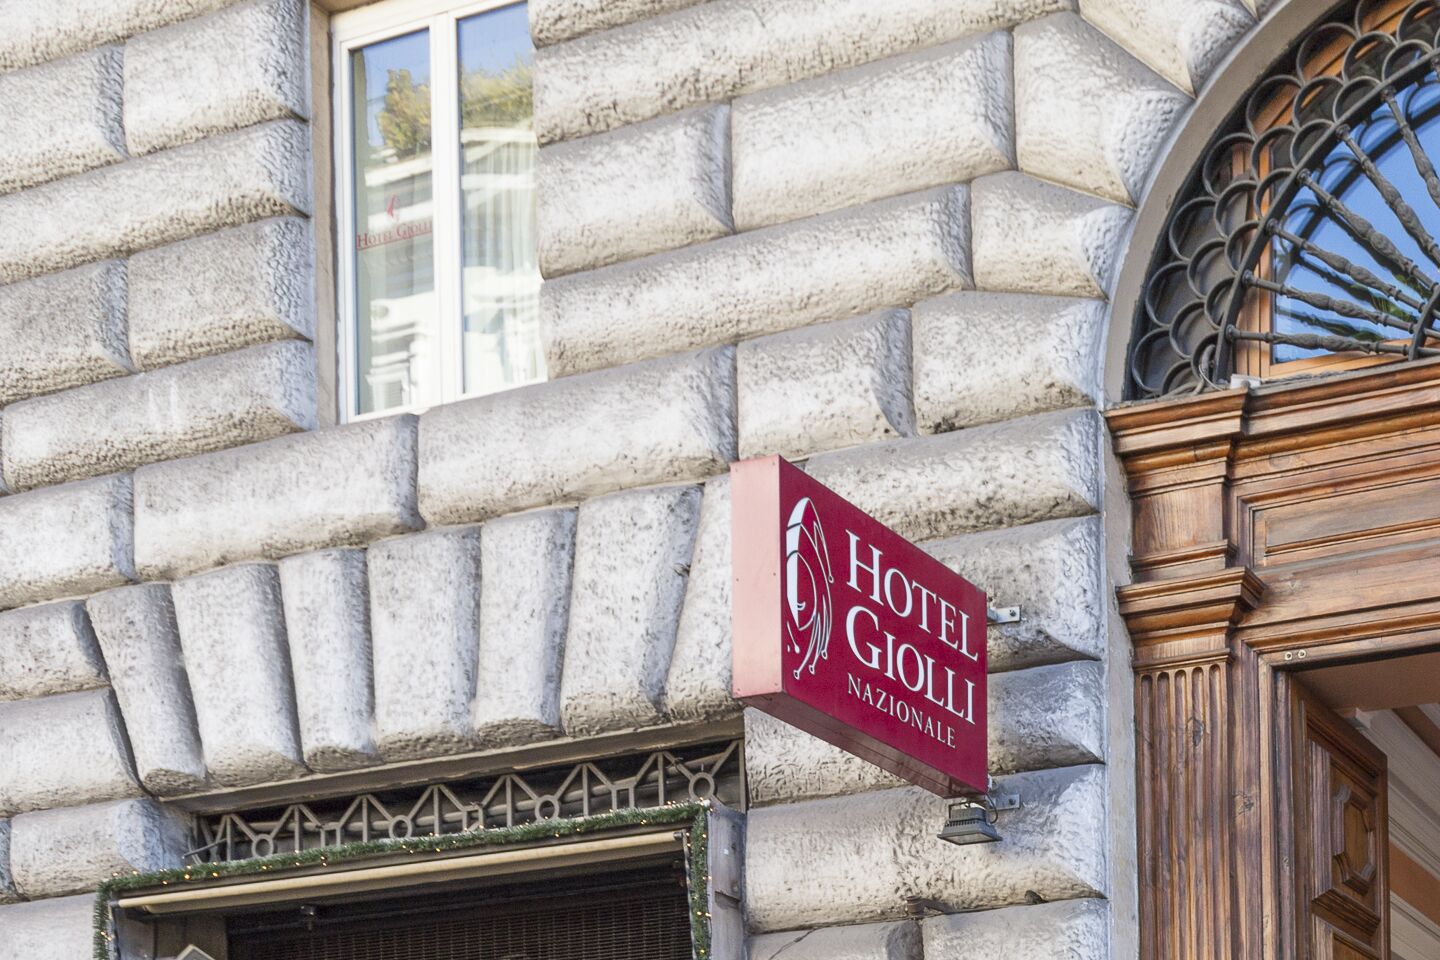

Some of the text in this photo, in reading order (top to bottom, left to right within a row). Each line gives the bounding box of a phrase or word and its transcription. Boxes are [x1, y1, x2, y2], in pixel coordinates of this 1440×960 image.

[845, 528, 979, 662] HOTEL
[845, 605, 976, 725] GIOLLI
[847, 672, 956, 749] NAZIONALE
